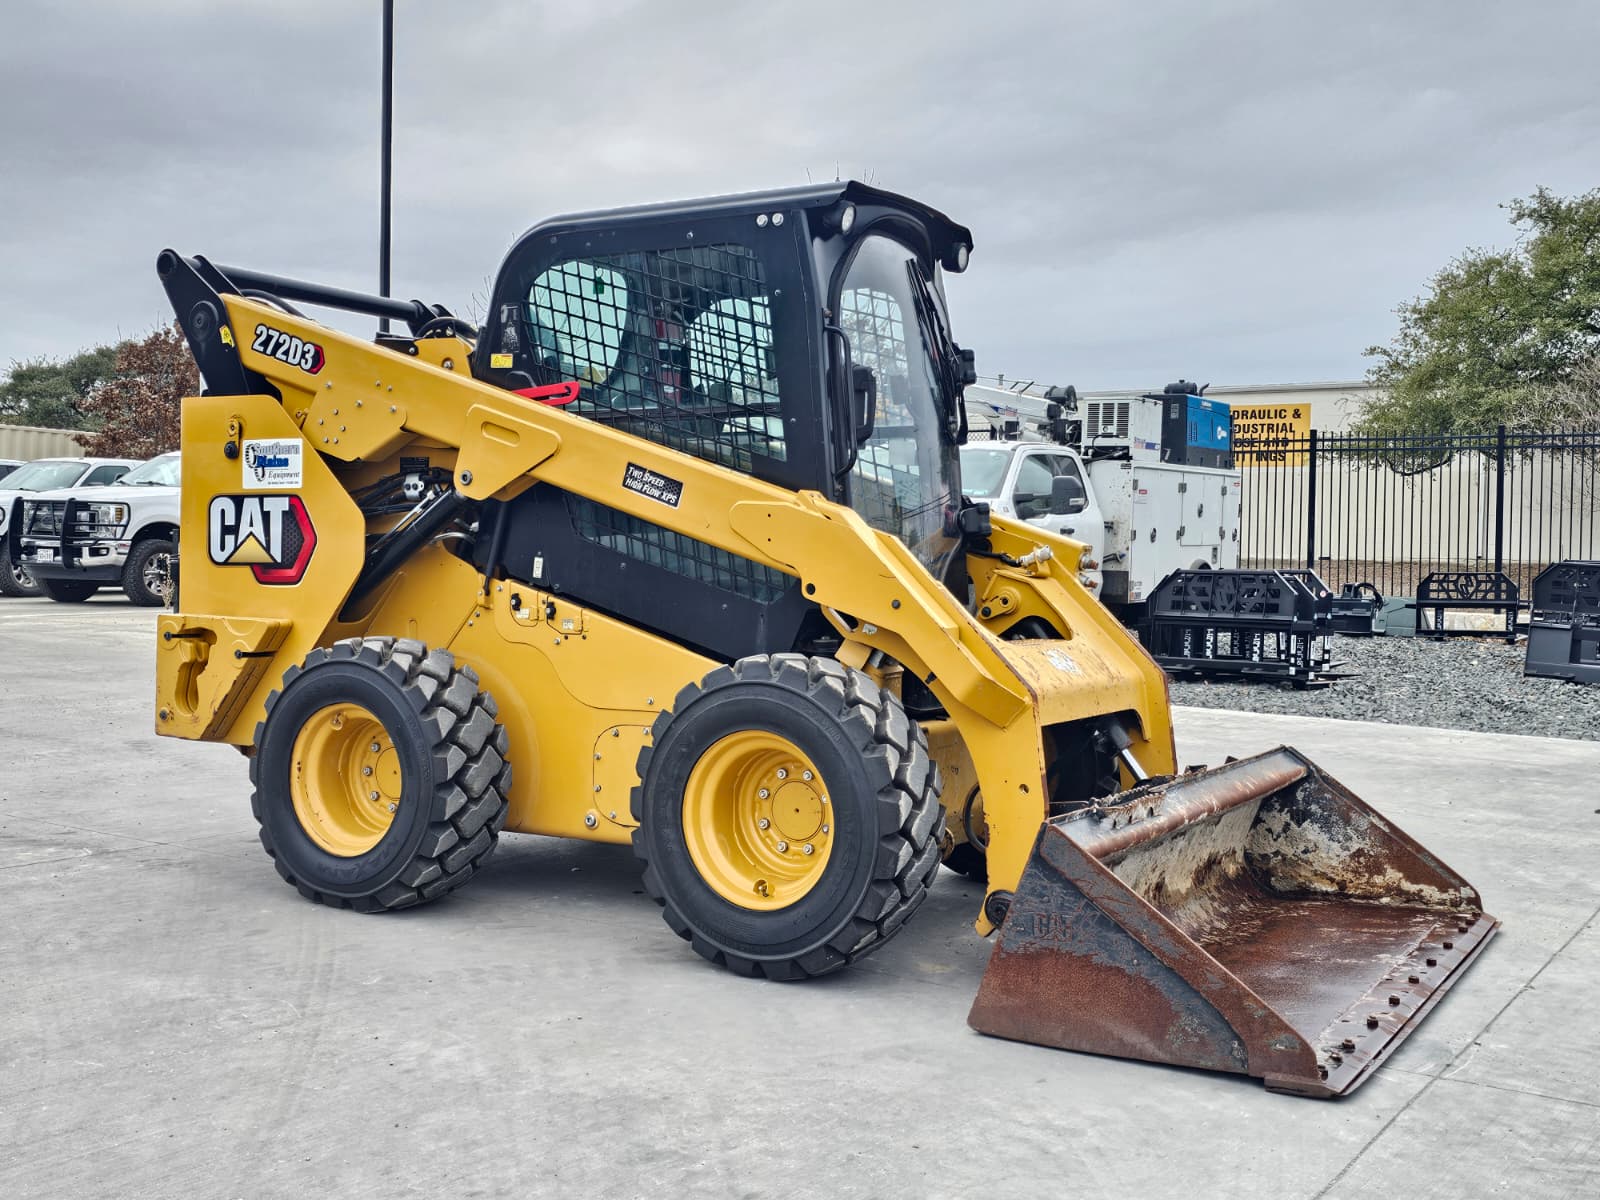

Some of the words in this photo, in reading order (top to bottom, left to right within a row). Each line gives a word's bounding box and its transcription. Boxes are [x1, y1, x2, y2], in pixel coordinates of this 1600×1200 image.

[252, 323, 315, 370] 272D3
[1231, 408, 1287, 420] DRAULIC
[1292, 408, 1302, 419] &
[1234, 422, 1295, 434] DUSTRIAL
[254, 441, 300, 455] Southern
[1233, 437, 1258, 448] OSE
[268, 471, 300, 480] Equipment
[661, 491, 678, 504] XPS
[209, 496, 289, 563] CAT
